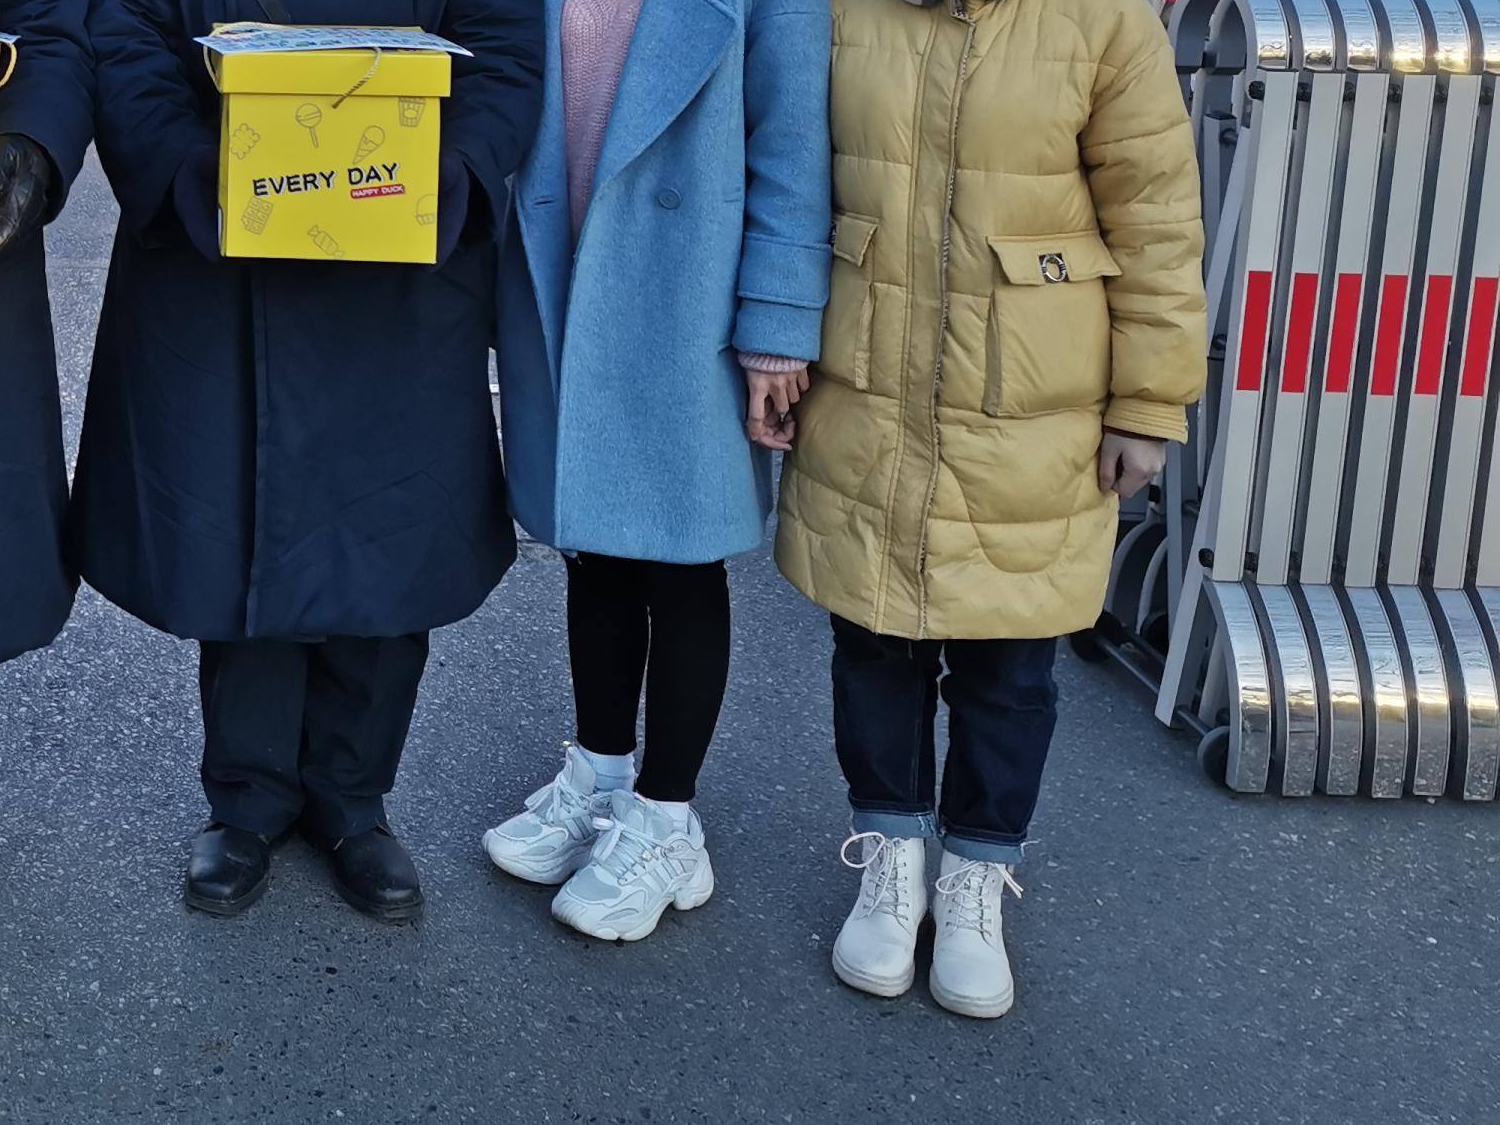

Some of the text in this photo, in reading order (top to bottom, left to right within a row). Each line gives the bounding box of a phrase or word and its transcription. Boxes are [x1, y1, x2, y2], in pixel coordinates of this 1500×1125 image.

[252, 162, 399, 196] EVERY DAY
[352, 185, 404, 197] HAPPY DUCK
